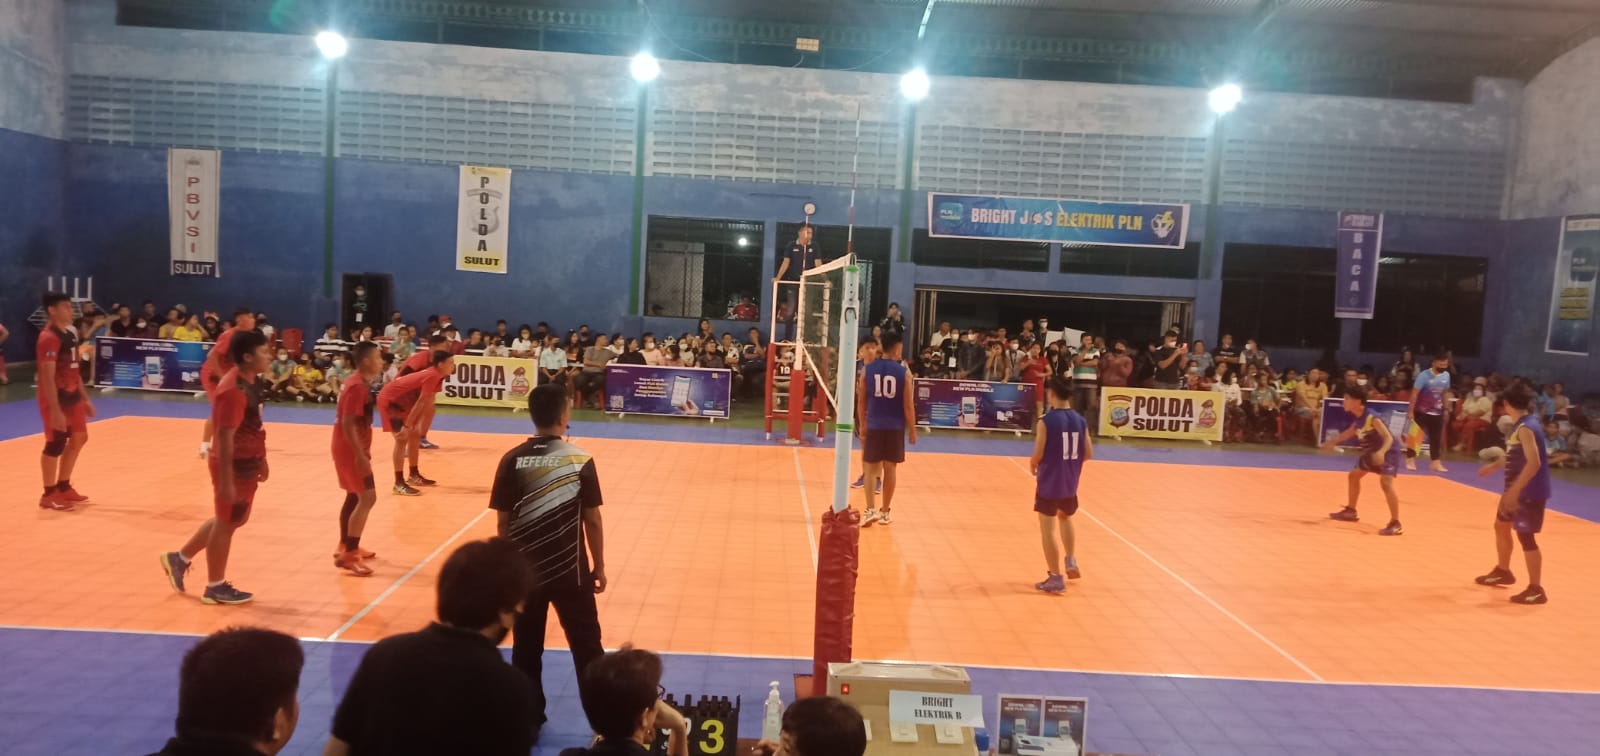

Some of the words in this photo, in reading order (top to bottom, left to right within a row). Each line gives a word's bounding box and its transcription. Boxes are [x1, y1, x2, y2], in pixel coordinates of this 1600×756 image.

[186, 177, 200, 253] PBVSI
[477, 176, 490, 251] POLDA
[971, 208, 1017, 224] BRIGHT
[1055, 212, 1115, 230] ELEKTRIK
[1118, 215, 1143, 230] PLN
[174, 263, 212, 274] SULUT
[464, 256, 500, 266] SULUT
[1350, 233, 1364, 291] BACA
[445, 363, 506, 386] OLDA
[445, 385, 506, 400] SULUT
[874, 374, 897, 399] 10
[1134, 396, 1193, 418] POLDA
[1133, 418, 1193, 432] SULUT
[1062, 432, 1079, 460] 11
[516, 455, 561, 470] REFEREE
[922, 696, 954, 707] BRIGHT
[914, 709, 953, 720] ELEKTRIK
[699, 719, 725, 754] 3
